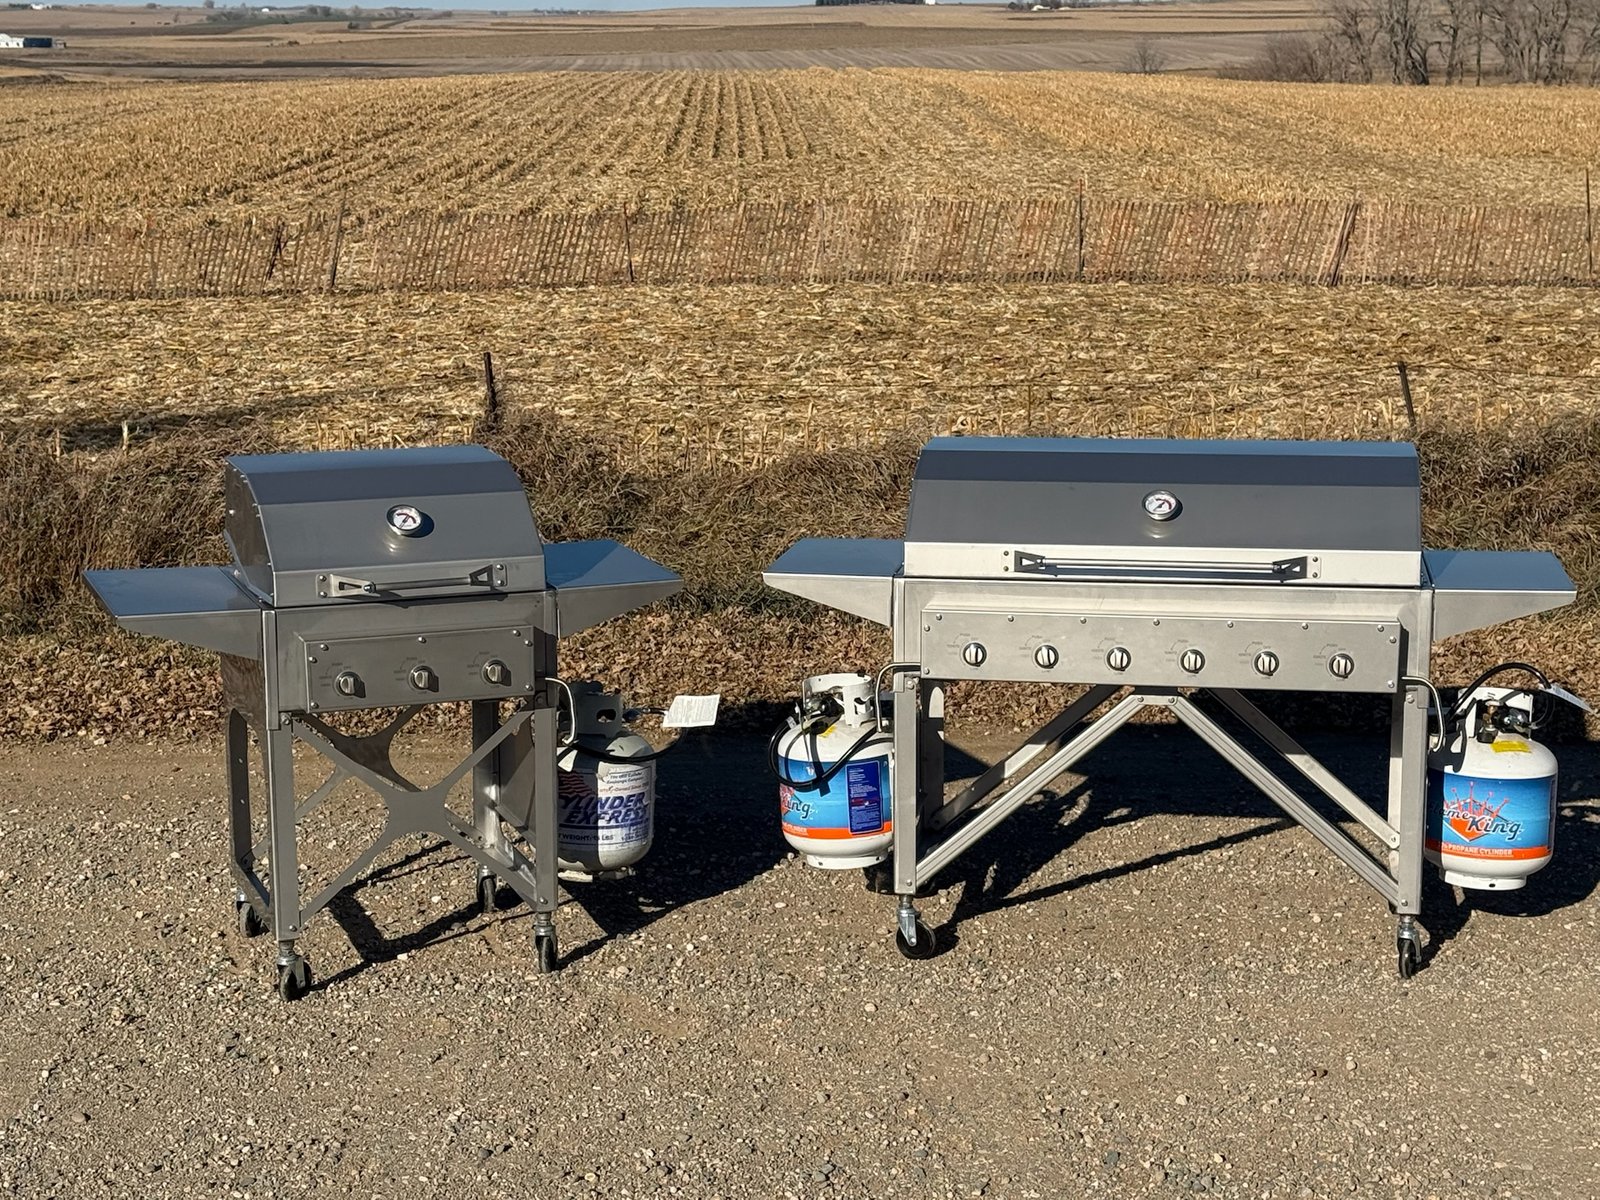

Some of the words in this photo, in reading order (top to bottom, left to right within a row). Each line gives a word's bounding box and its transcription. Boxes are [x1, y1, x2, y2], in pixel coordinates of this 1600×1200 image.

[558, 792, 646, 811] YLINDER
[564, 806, 648, 825] EXPRESS
[1467, 816, 1522, 842] King
[1449, 844, 1478, 854] PROPANE
[1479, 847, 1512, 856] CYLINDER
